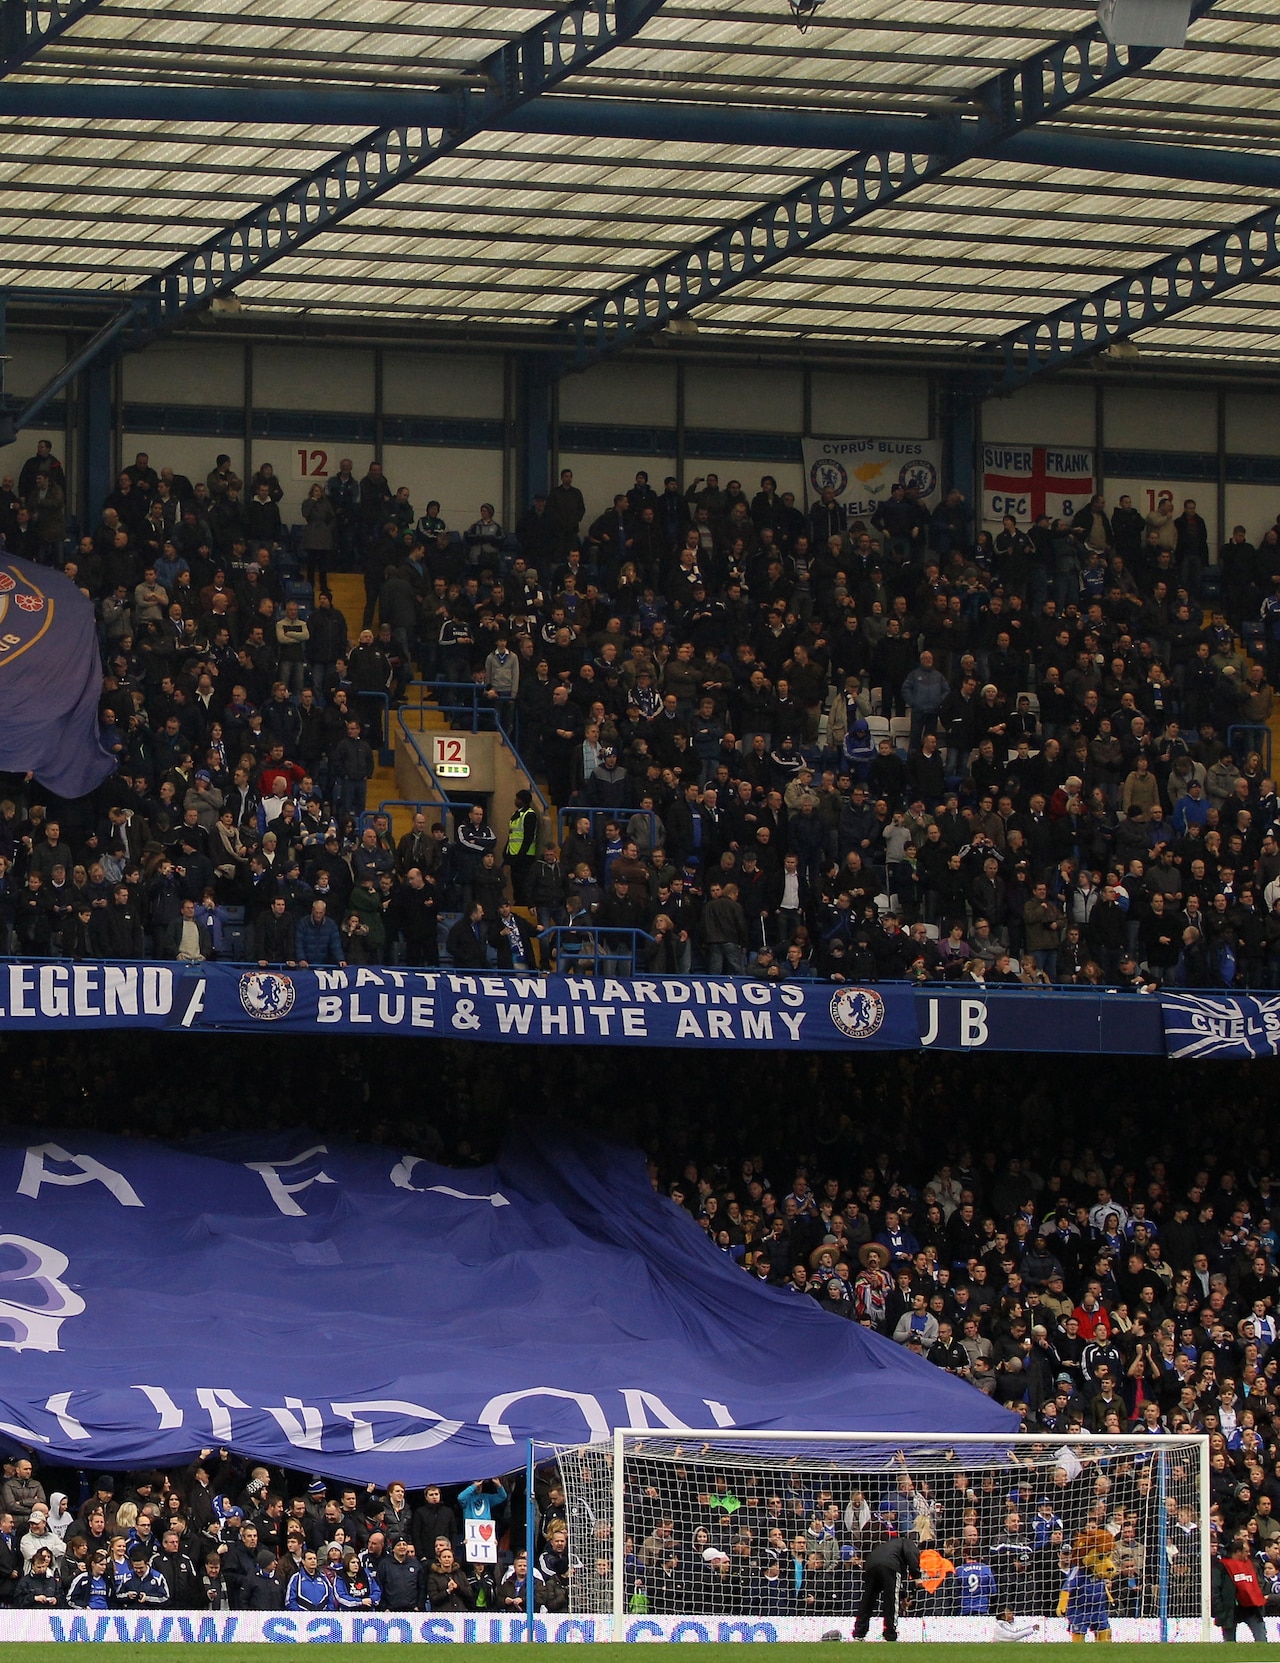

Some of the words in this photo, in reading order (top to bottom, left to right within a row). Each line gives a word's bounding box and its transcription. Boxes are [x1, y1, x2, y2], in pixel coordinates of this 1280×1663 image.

[822, 440, 874, 456] CYPRUS
[878, 442, 922, 455] BLUES
[297, 450, 328, 477] 12
[984, 450, 1032, 473] SUPER
[1046, 453, 1090, 473] FRANK
[992, 495, 1028, 517] CFC
[1062, 499, 1074, 517] 8
[437, 740, 462, 762] 12
[313, 968, 548, 999] MATTHEW
[564, 978, 807, 1007] HARDING'S
[316, 995, 435, 1028] BLUE
[451, 999, 481, 1030] &
[496, 1003, 648, 1037] WHITE
[676, 1009, 807, 1041] ARMY
[1191, 1013, 1280, 1038] CHELS
[471, 1524, 477, 1538] I
[968, 1574, 979, 1593] 9
